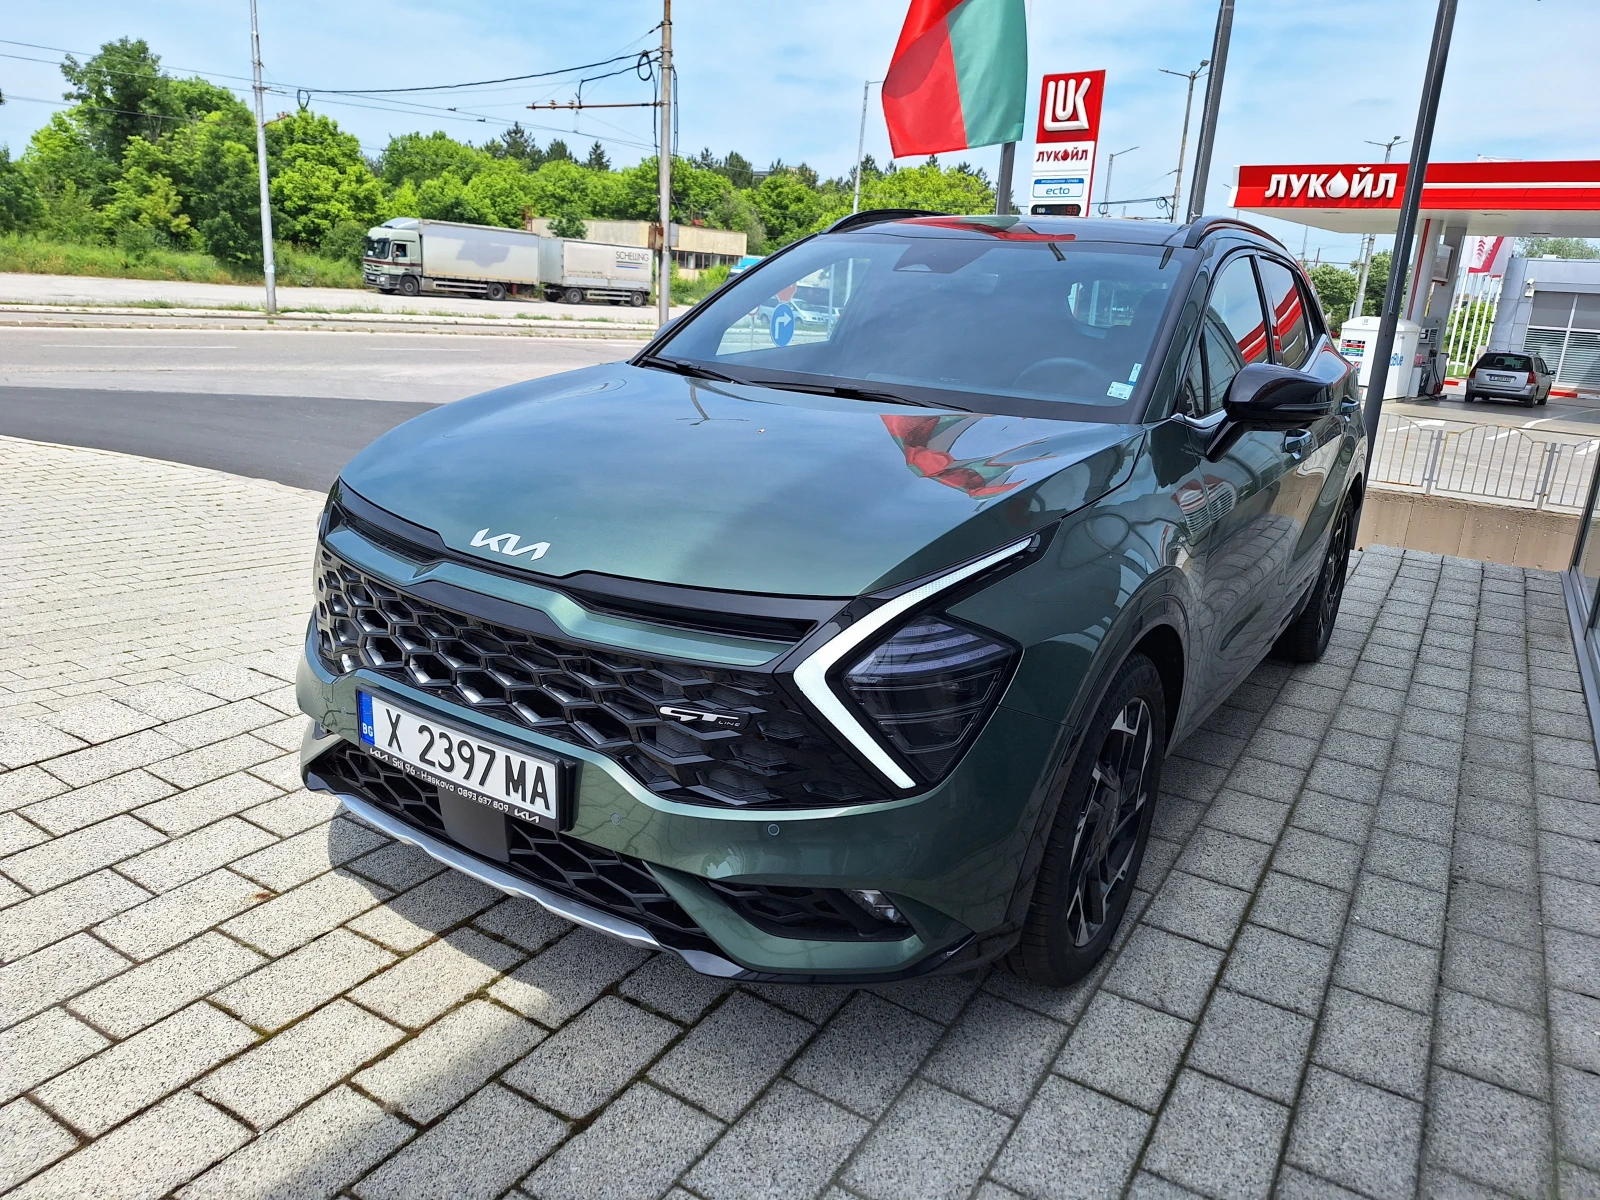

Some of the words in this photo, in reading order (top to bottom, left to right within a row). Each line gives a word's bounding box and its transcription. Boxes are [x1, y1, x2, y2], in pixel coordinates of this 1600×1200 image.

[1036, 147, 1088, 162] ЛУКОЙЛ
[1046, 187, 1070, 195] ecto
[1264, 166, 1398, 198] ЛУКОЙЛ
[615, 251, 649, 261] SCHELLING
[470, 528, 550, 561] KIA
[362, 722, 374, 737] BG
[385, 708, 403, 754] X
[418, 724, 497, 787] 2397
[504, 754, 551, 811] MA
[404, 763, 416, 776] 96
[457, 787, 477, 801] 0893
[477, 795, 492, 806] 637
[492, 801, 509, 813] 809
